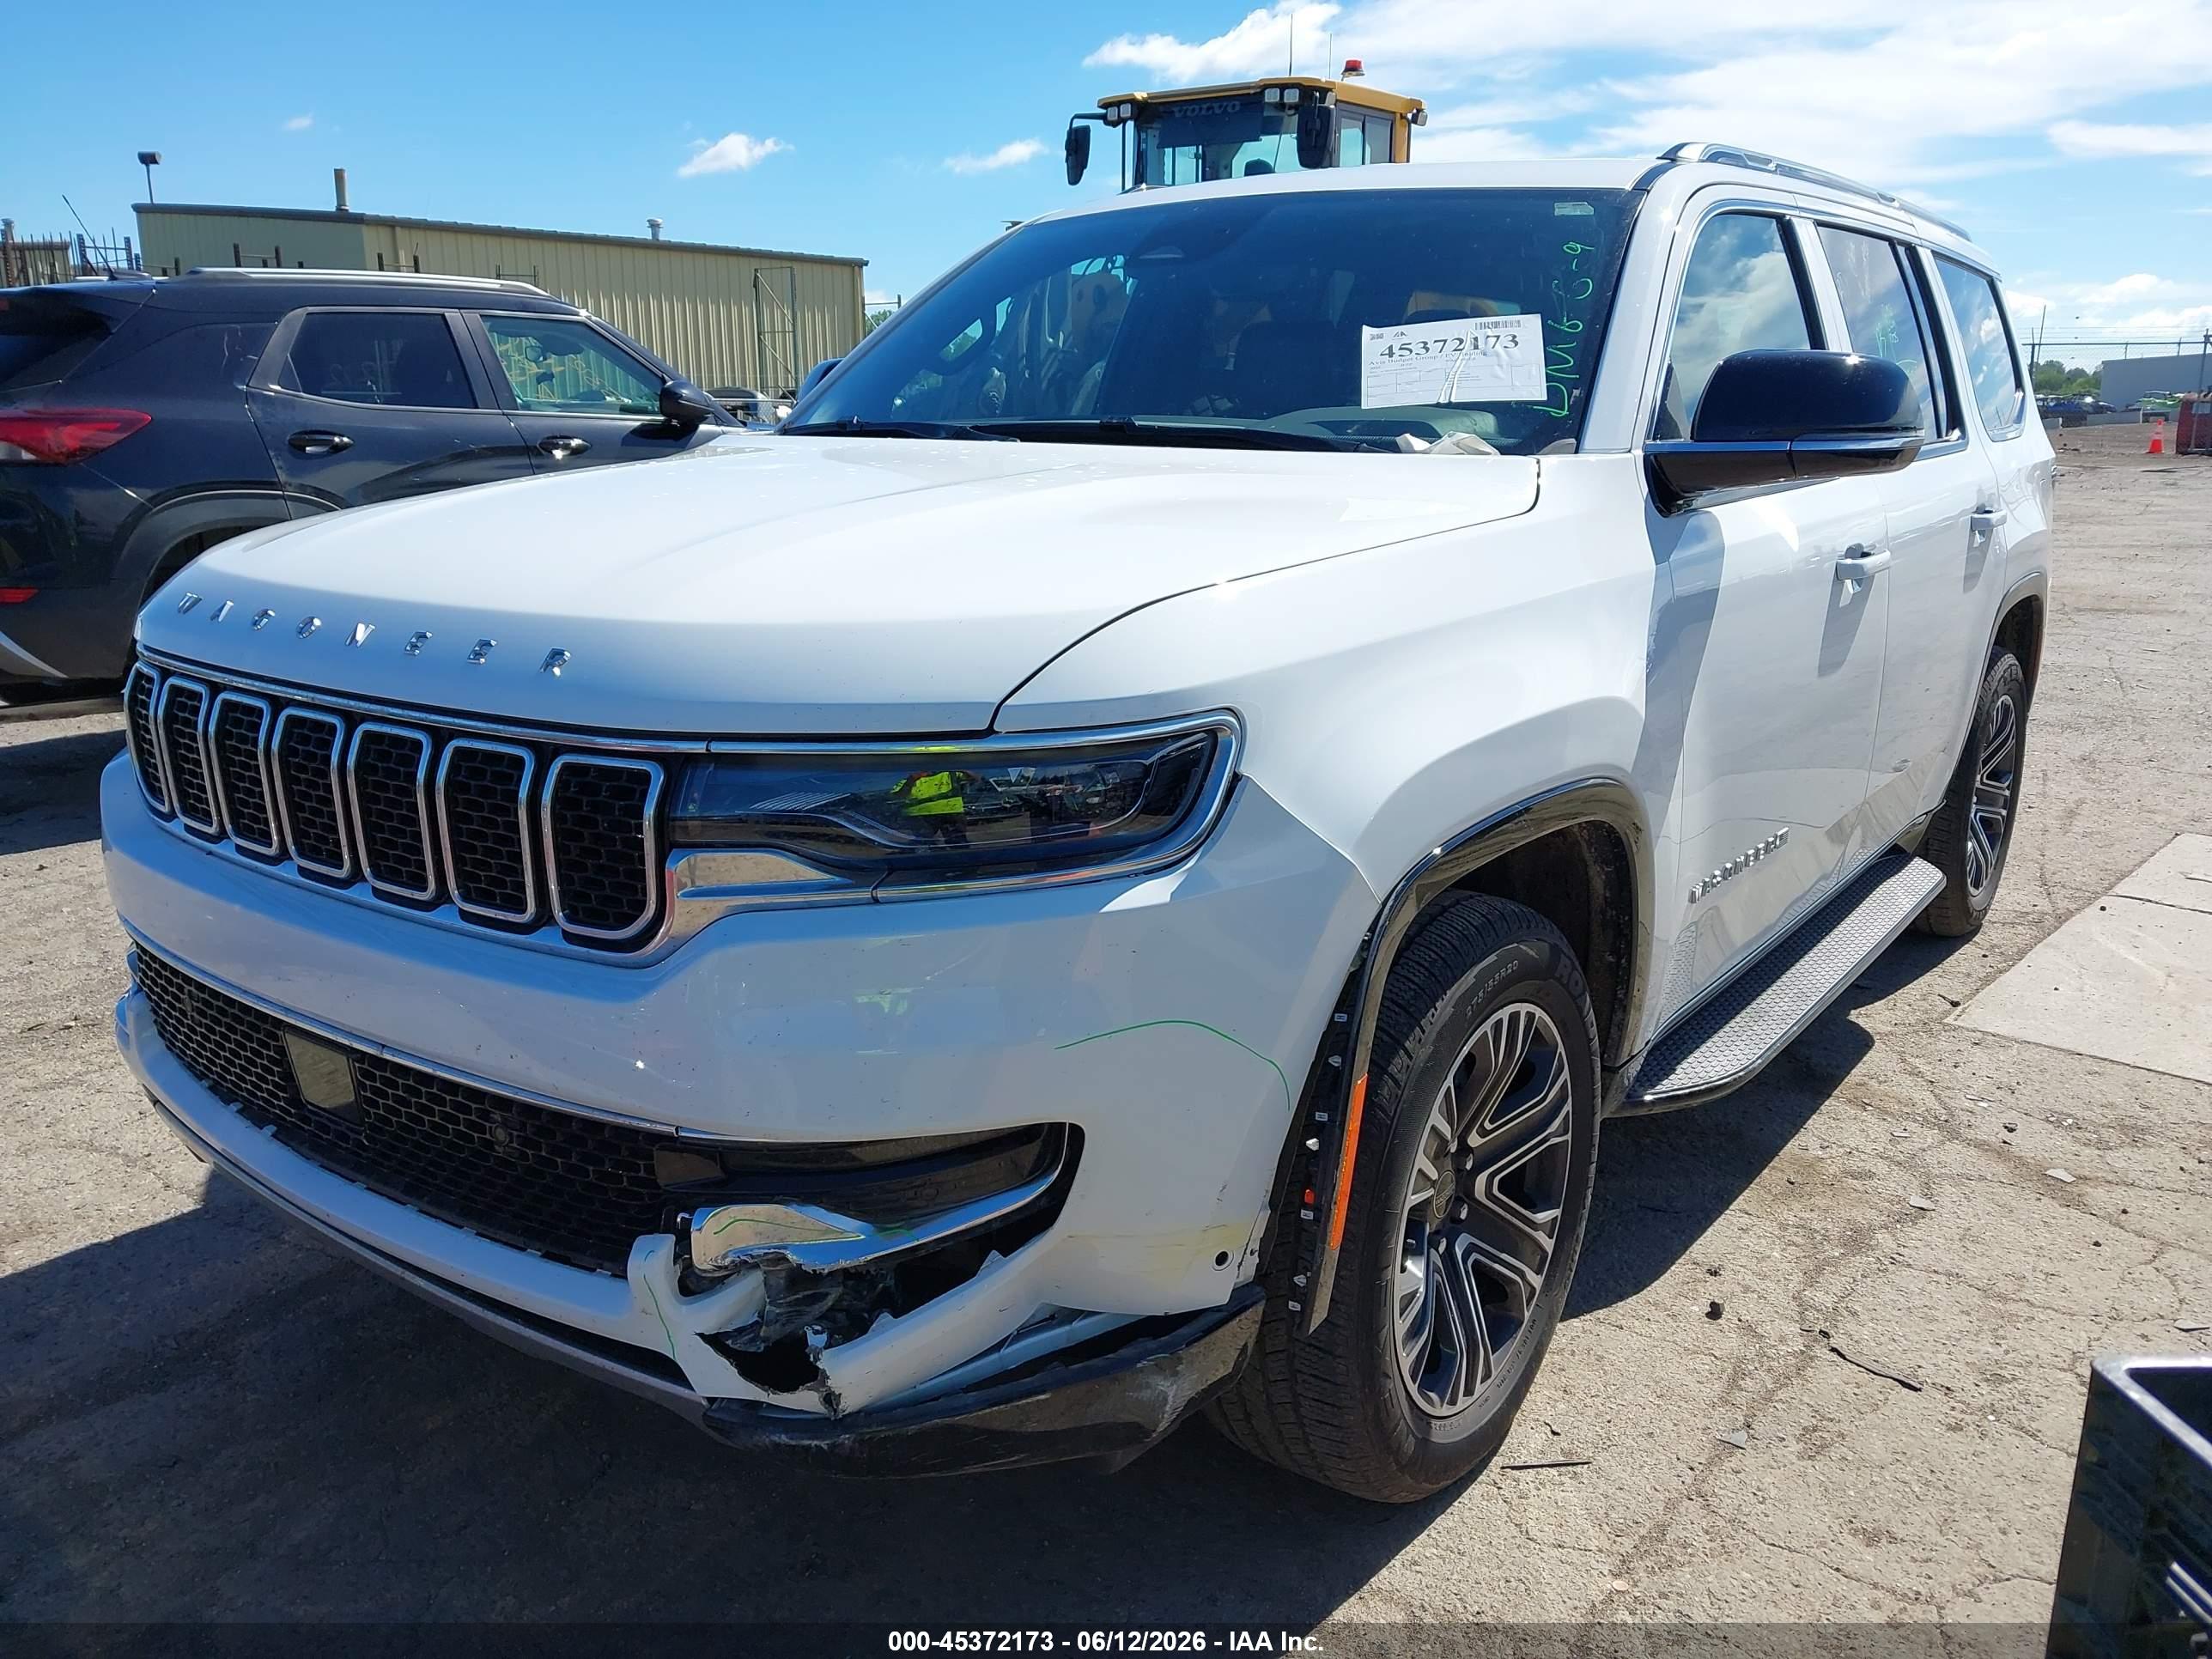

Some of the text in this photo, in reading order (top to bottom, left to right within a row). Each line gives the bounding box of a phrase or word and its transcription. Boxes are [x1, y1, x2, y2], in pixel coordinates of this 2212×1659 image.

[1173, 100, 1242, 118] VOLVO
[1378, 333, 1519, 359] 45372173
[176, 591, 572, 678] WAGONEER
